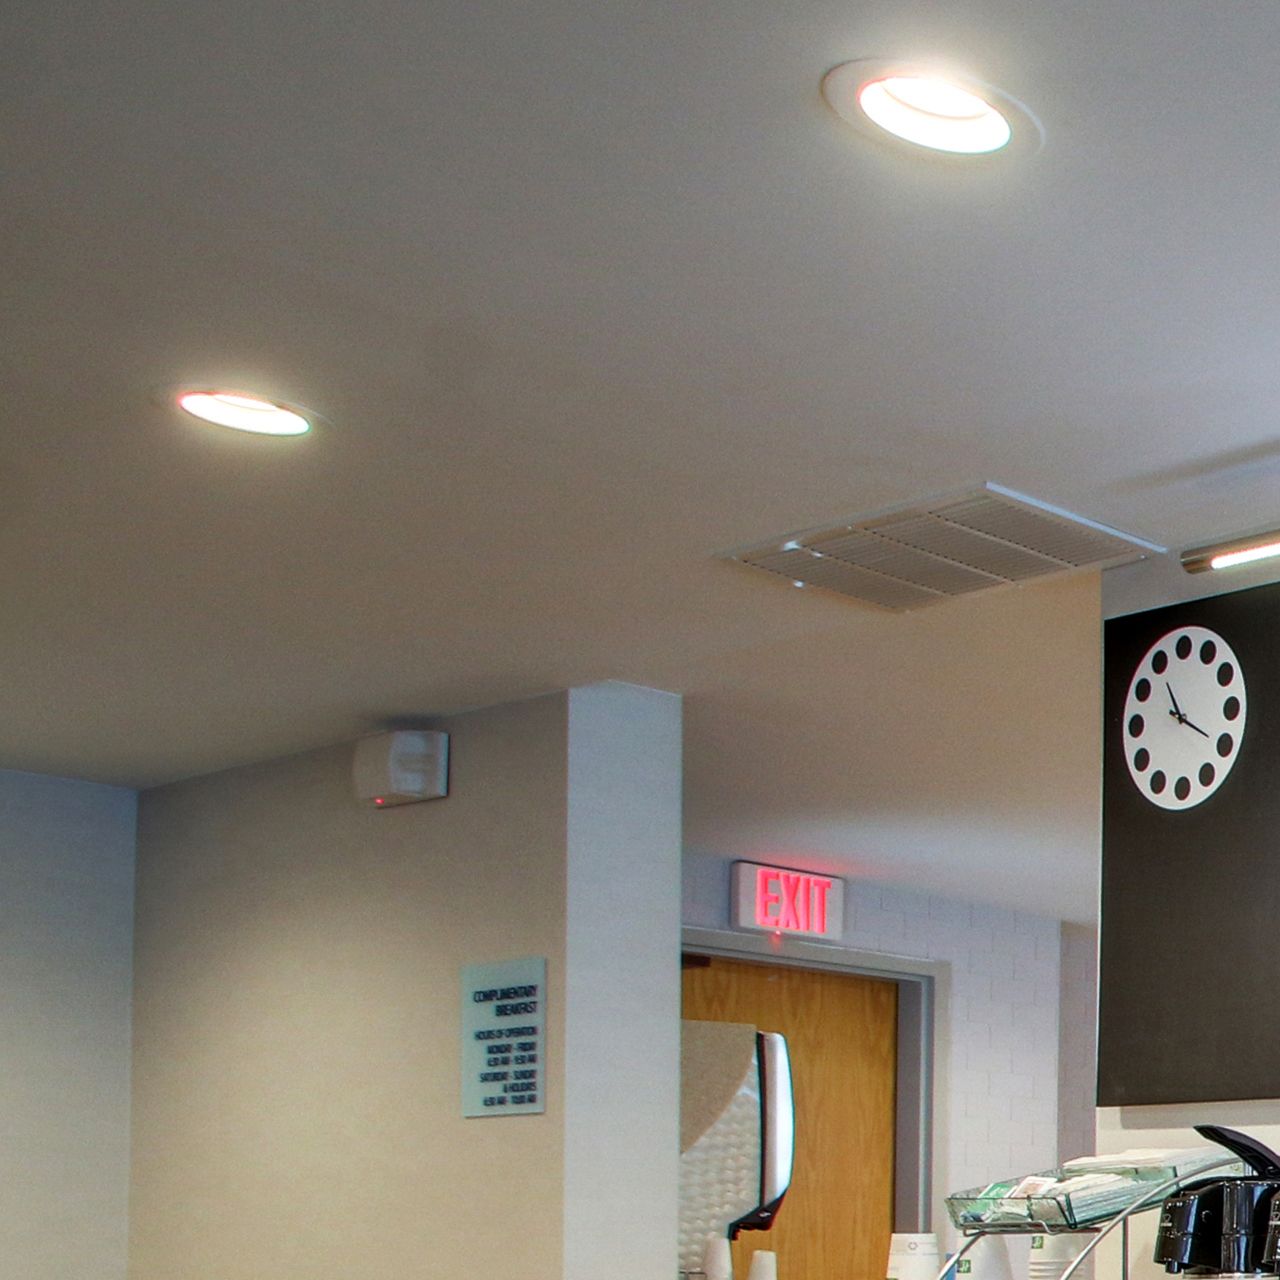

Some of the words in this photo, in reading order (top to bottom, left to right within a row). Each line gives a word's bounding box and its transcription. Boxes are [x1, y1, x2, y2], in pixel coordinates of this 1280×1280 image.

[755, 868, 832, 934] EXIT
[473, 984, 538, 1003] COMPLIMENTARY
[495, 1001, 538, 1016] BREAKFAST
